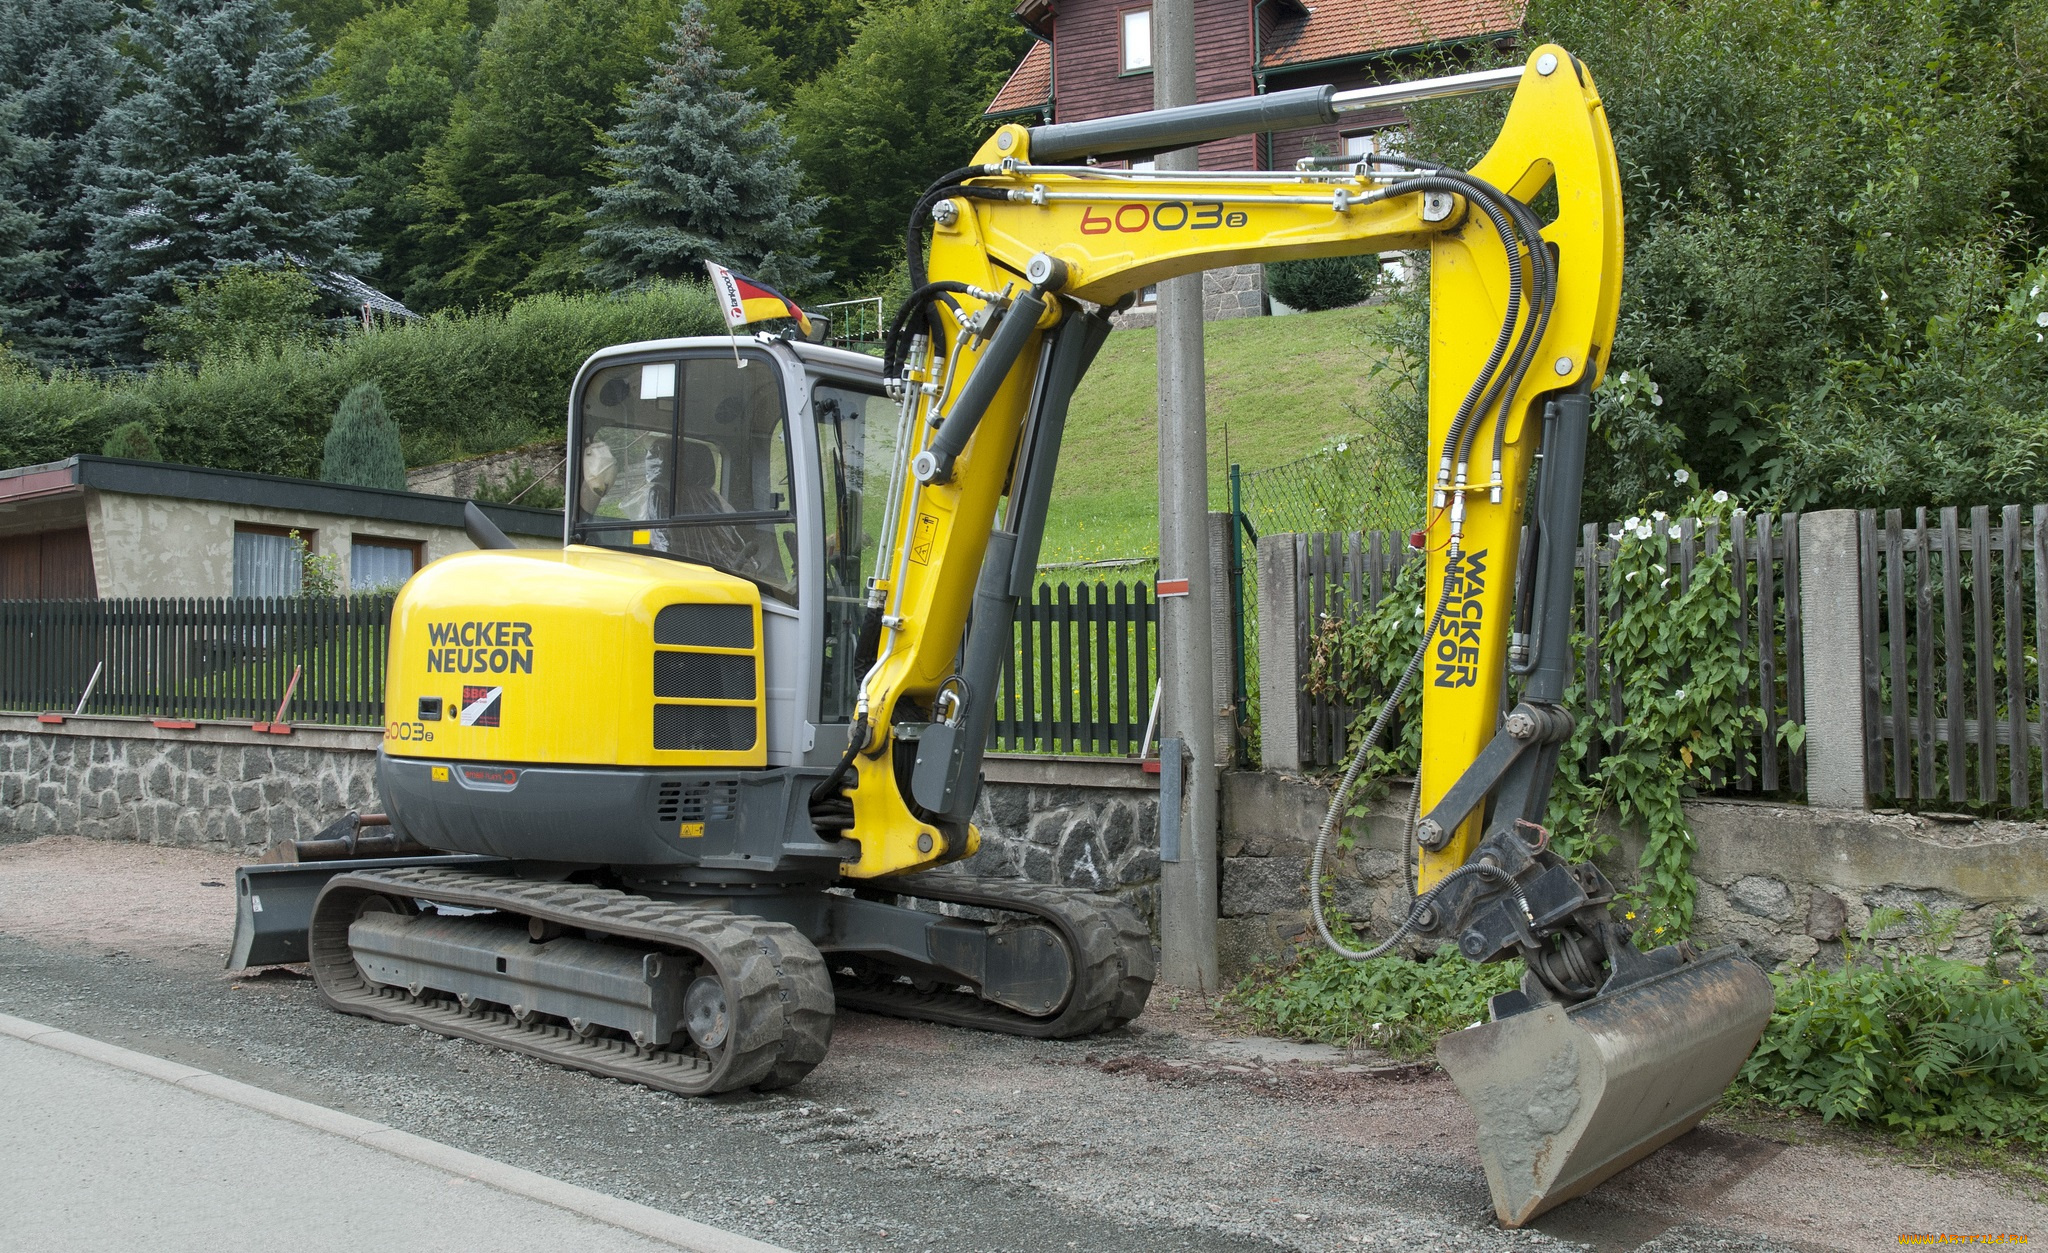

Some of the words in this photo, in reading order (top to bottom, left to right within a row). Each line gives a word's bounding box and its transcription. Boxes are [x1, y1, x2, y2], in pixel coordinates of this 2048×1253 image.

[1434, 550, 1466, 688] NEUSON
[1455, 549, 1488, 689] WACKER
[427, 621, 534, 647] WACKER
[427, 648, 534, 674] NEUSON
[463, 687, 488, 699] SBG
